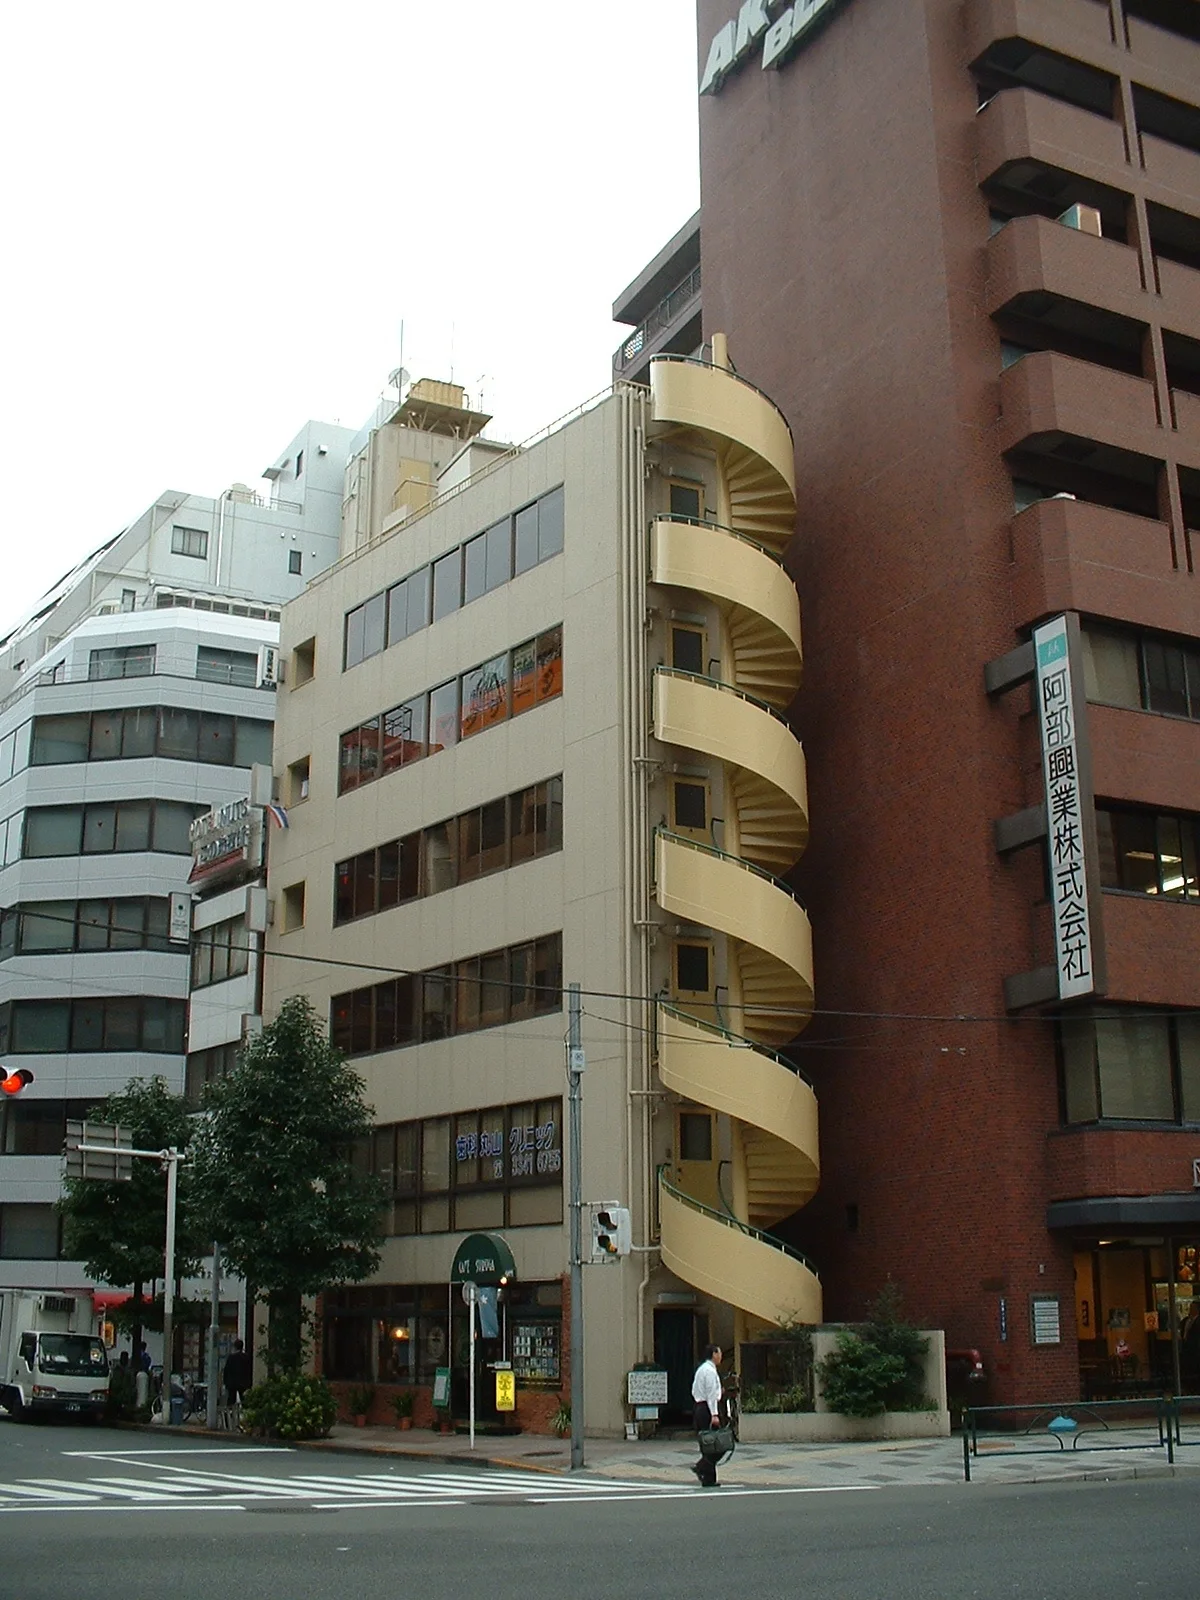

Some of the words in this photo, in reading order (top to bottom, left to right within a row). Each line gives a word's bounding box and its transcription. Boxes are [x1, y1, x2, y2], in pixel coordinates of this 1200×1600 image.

[700, 0, 777, 95] AK
[762, 0, 830, 70] BL
[1042, 668, 1090, 982] 阿部興業株式会社
